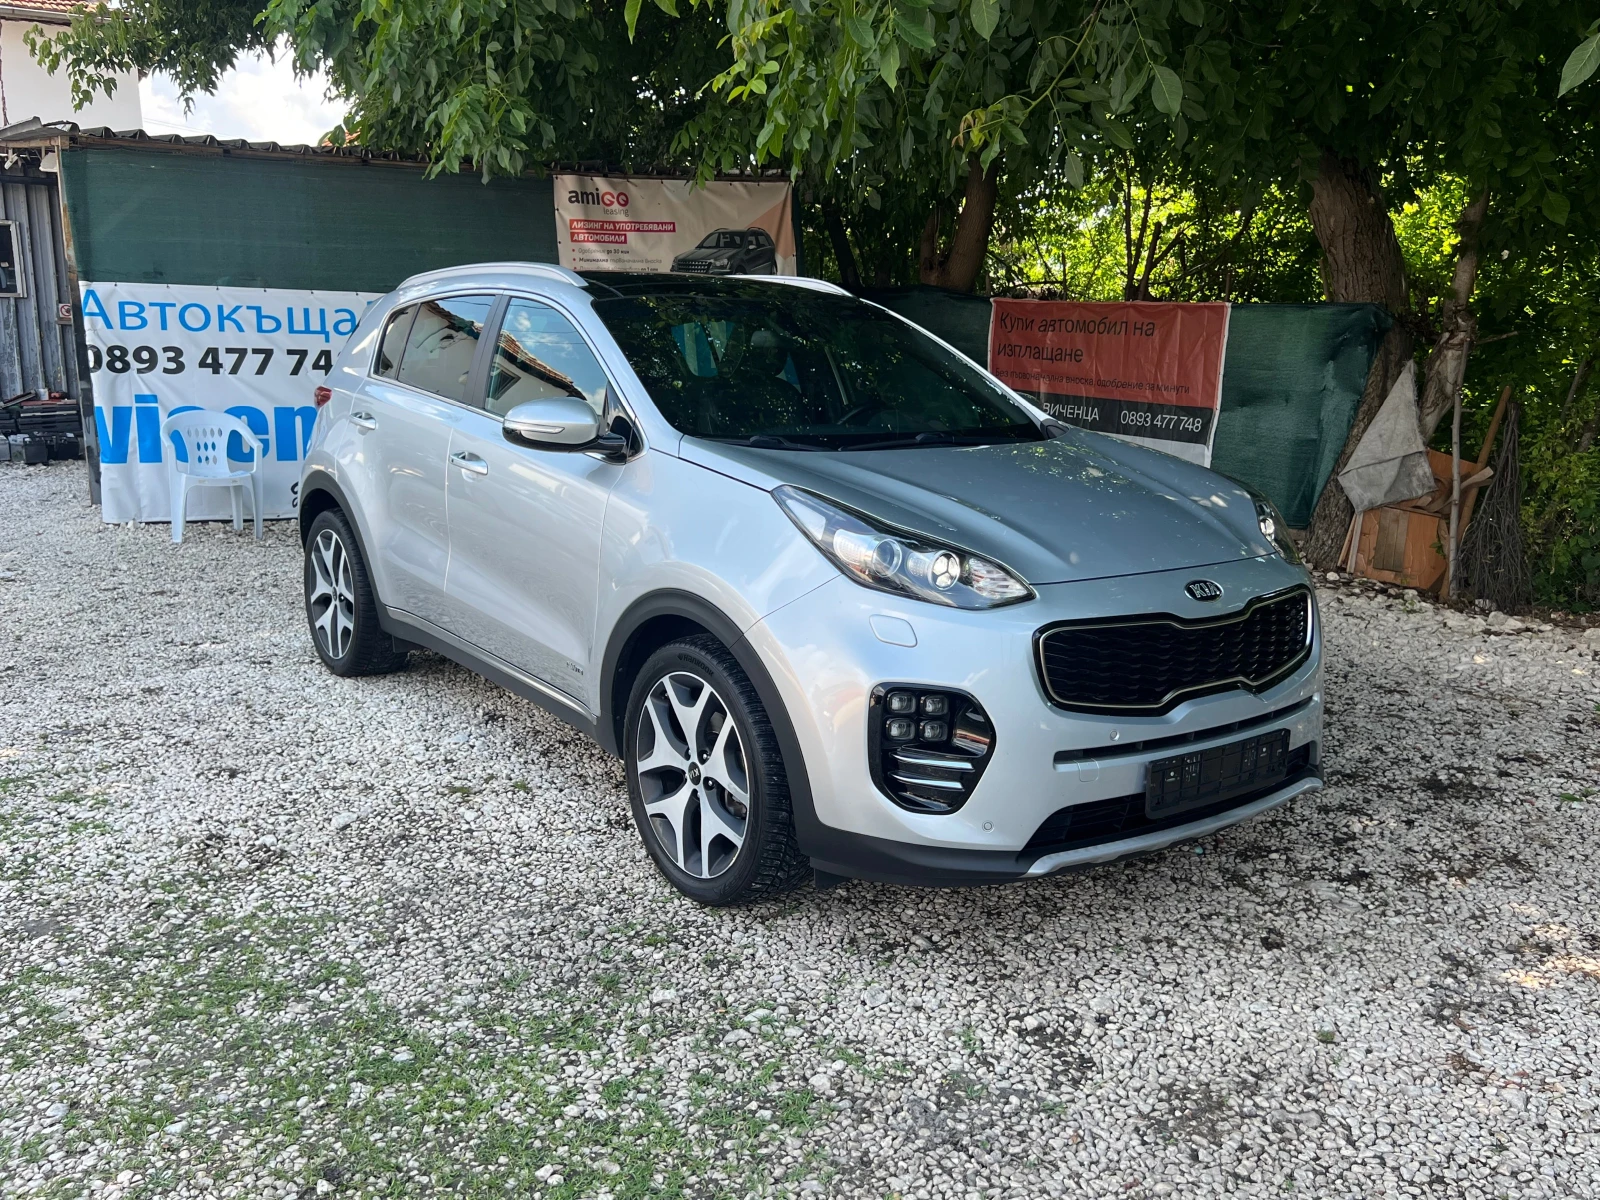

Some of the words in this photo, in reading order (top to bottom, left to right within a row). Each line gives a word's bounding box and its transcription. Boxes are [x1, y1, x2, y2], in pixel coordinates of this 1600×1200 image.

[603, 207, 629, 217] leasing
[571, 221, 602, 230] ЛИЗИНГ
[603, 222, 614, 230] НА
[615, 223, 674, 231] УПОТРЕБЯВАНИ
[572, 232, 625, 242] АВТОМОБИЛИ
[82, 289, 356, 343] Автокъща
[1000, 312, 1034, 333] Купи
[1038, 317, 1128, 336] автомобил
[1133, 321, 1156, 337] на
[87, 345, 186, 374] 0893
[198, 347, 274, 375] 477
[286, 349, 341, 376] 74
[997, 343, 1084, 363] изплащане
[995, 368, 1009, 377] Без
[1010, 370, 1063, 383] първоначална
[1096, 379, 1144, 391] одобрение
[1155, 385, 1190, 395] минути
[1042, 402, 1100, 422] ВИЧЕНЦА
[1120, 410, 1151, 426] 0893
[1153, 414, 1178, 430] 477
[1179, 416, 1202, 432] 748
[1189, 582, 1221, 598] KIA
